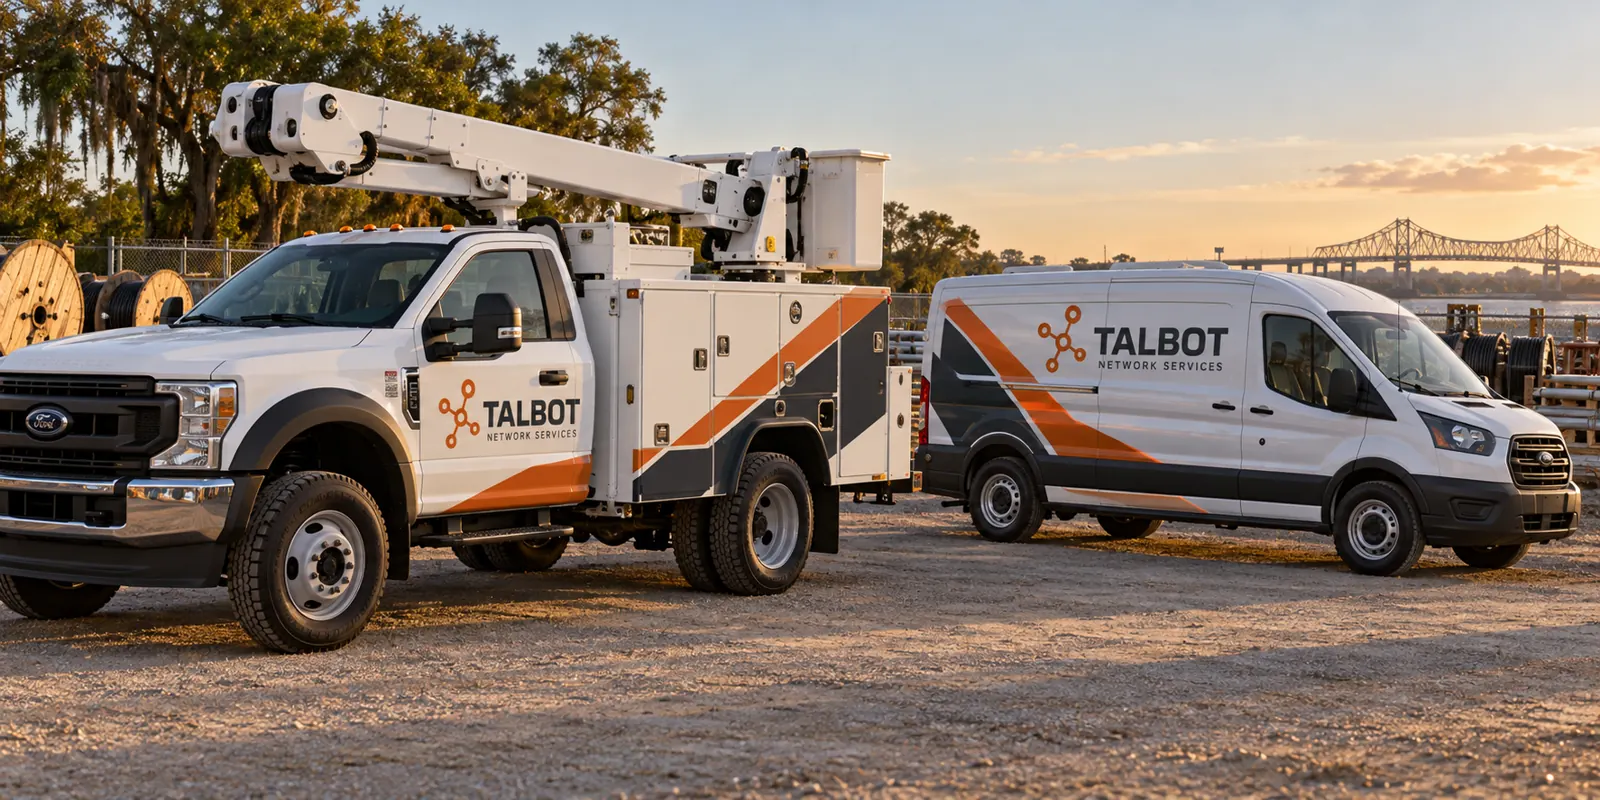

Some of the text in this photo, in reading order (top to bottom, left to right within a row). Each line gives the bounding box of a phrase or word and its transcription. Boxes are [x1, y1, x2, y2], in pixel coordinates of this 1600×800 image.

[1094, 327, 1229, 356] TALBOT
[1098, 360, 1223, 372] NETWORK SERVICES
[33, 413, 56, 429] Ford
[483, 398, 580, 428] TALBOT
[487, 429, 577, 442] NETWORK SERVICES
